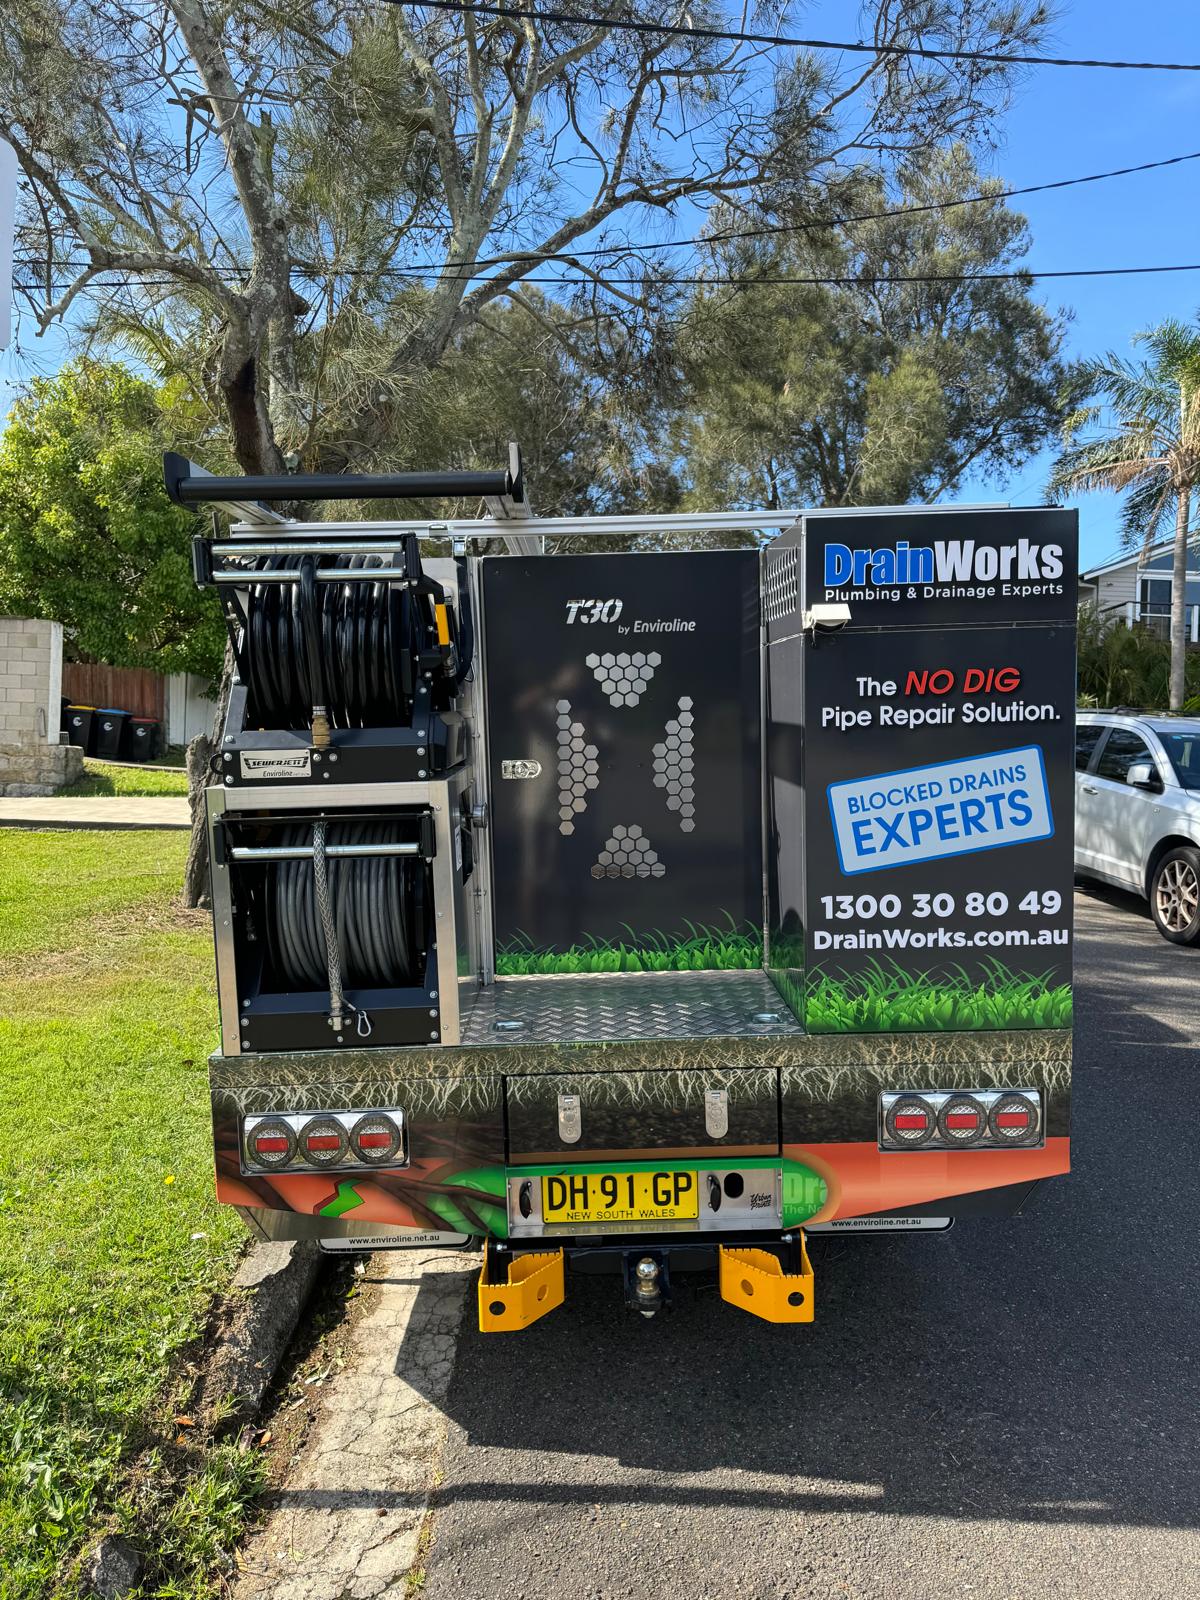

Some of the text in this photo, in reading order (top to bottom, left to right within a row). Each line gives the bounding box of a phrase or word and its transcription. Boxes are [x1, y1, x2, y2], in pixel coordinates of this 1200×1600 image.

[824, 538, 1064, 586] DrainWorks
[825, 583, 1063, 601] Plumbing & Drainage Experts
[565, 599, 623, 624] T30
[618, 618, 696, 635] by Enviroline
[856, 667, 1021, 696] The NO DIG
[822, 701, 1061, 731] Pipe Repair Solution.
[847, 764, 1027, 815] BLOCKED DRAINS
[851, 789, 1033, 857] EXPERTS
[820, 890, 1062, 920] 1300 30 80 49
[814, 928, 1069, 950] DrainWorks.com.au
[567, 1208, 676, 1220] NEW SOUTH WALES
[784, 1204, 804, 1215] The
[831, 1218, 922, 1227] www.enviroline.net.au
[349, 1234, 440, 1244] www.enviroline.net.au
